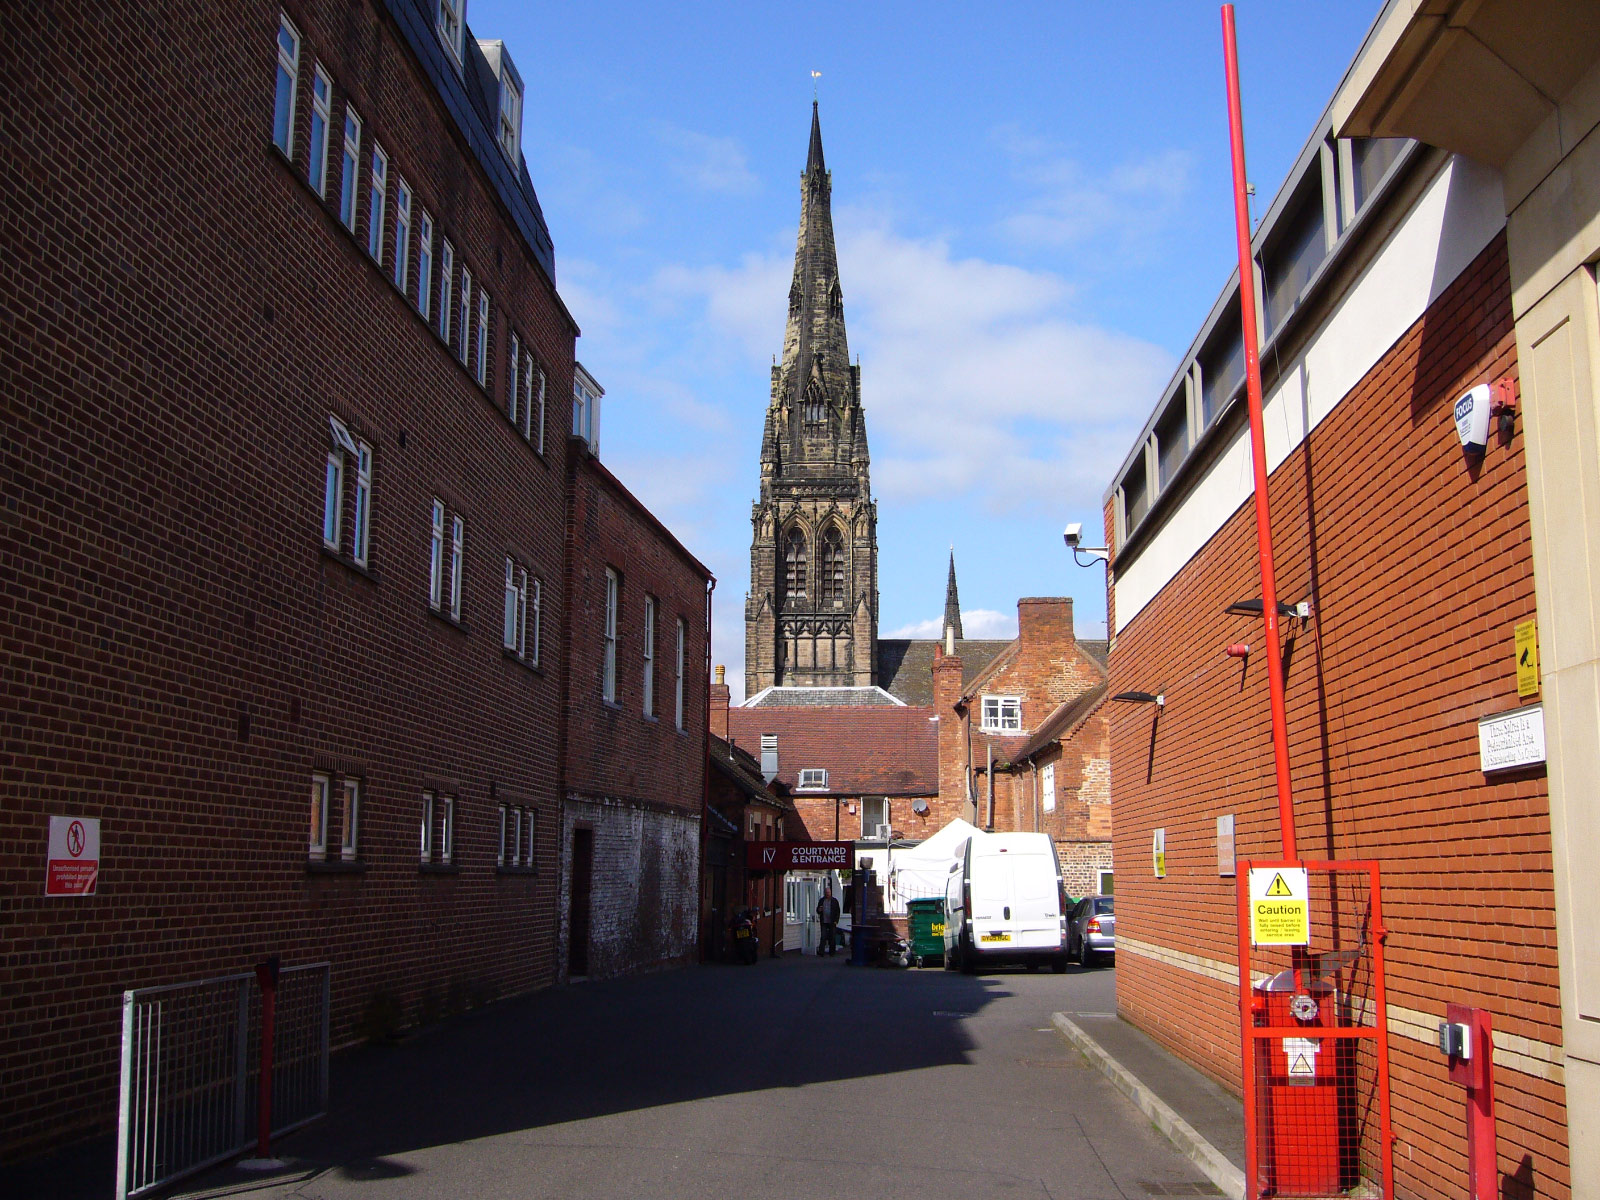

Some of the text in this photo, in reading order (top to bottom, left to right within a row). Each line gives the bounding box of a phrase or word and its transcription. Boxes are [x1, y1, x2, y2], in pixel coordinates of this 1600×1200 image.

[1456, 398, 1473, 420] FOCUS
[792, 847, 846, 855] COURTYARD
[792, 855, 846, 863] & ENTRANCE
[1257, 905, 1301, 914] Caution
